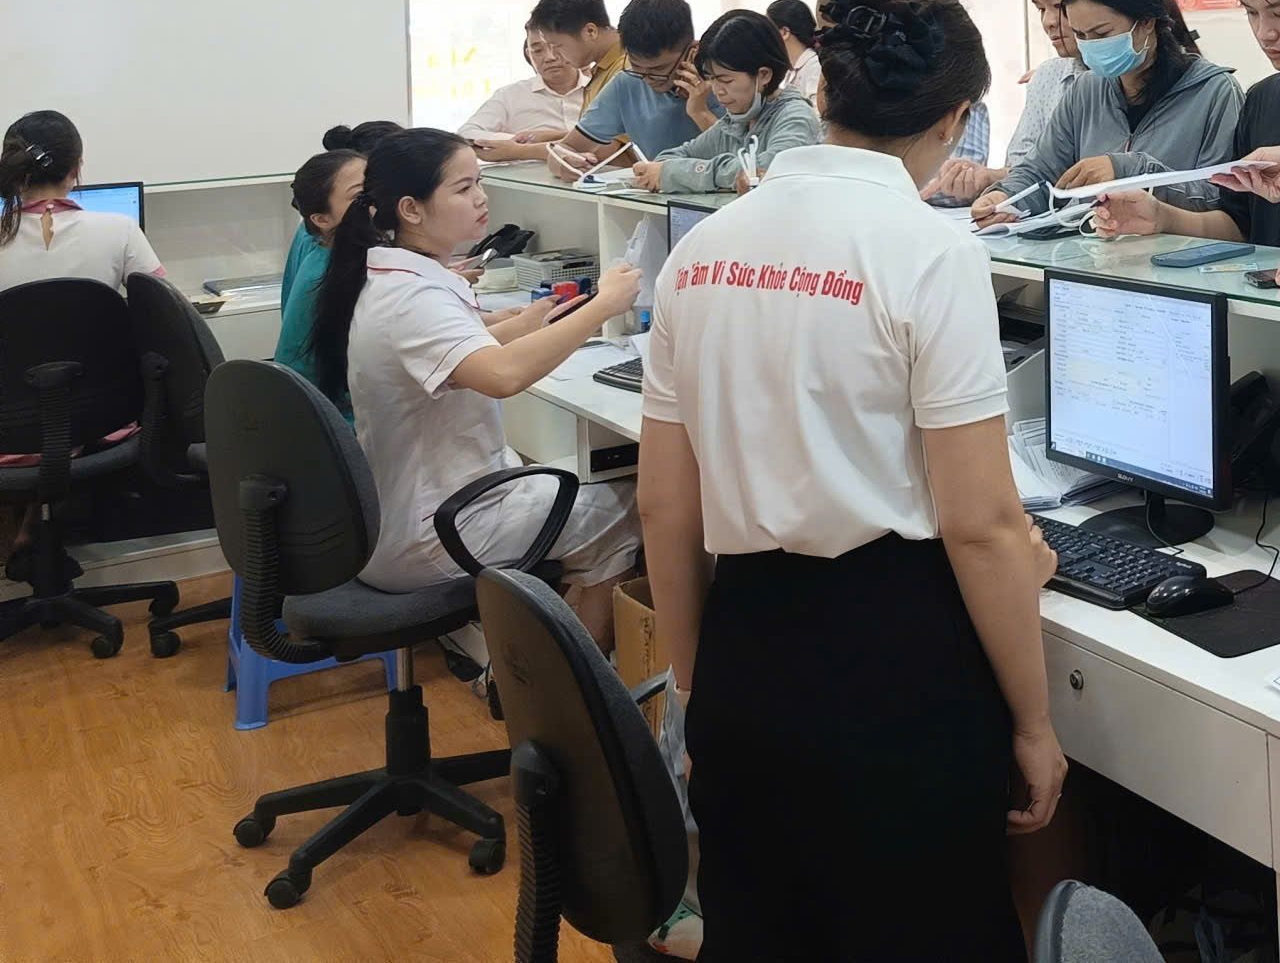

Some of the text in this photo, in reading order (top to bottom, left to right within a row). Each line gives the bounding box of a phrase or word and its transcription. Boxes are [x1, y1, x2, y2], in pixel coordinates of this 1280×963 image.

[691, 260, 709, 286] âm
[726, 261, 756, 287] Sức
[788, 266, 822, 297] Cộng
[821, 270, 864, 306] Đồng
